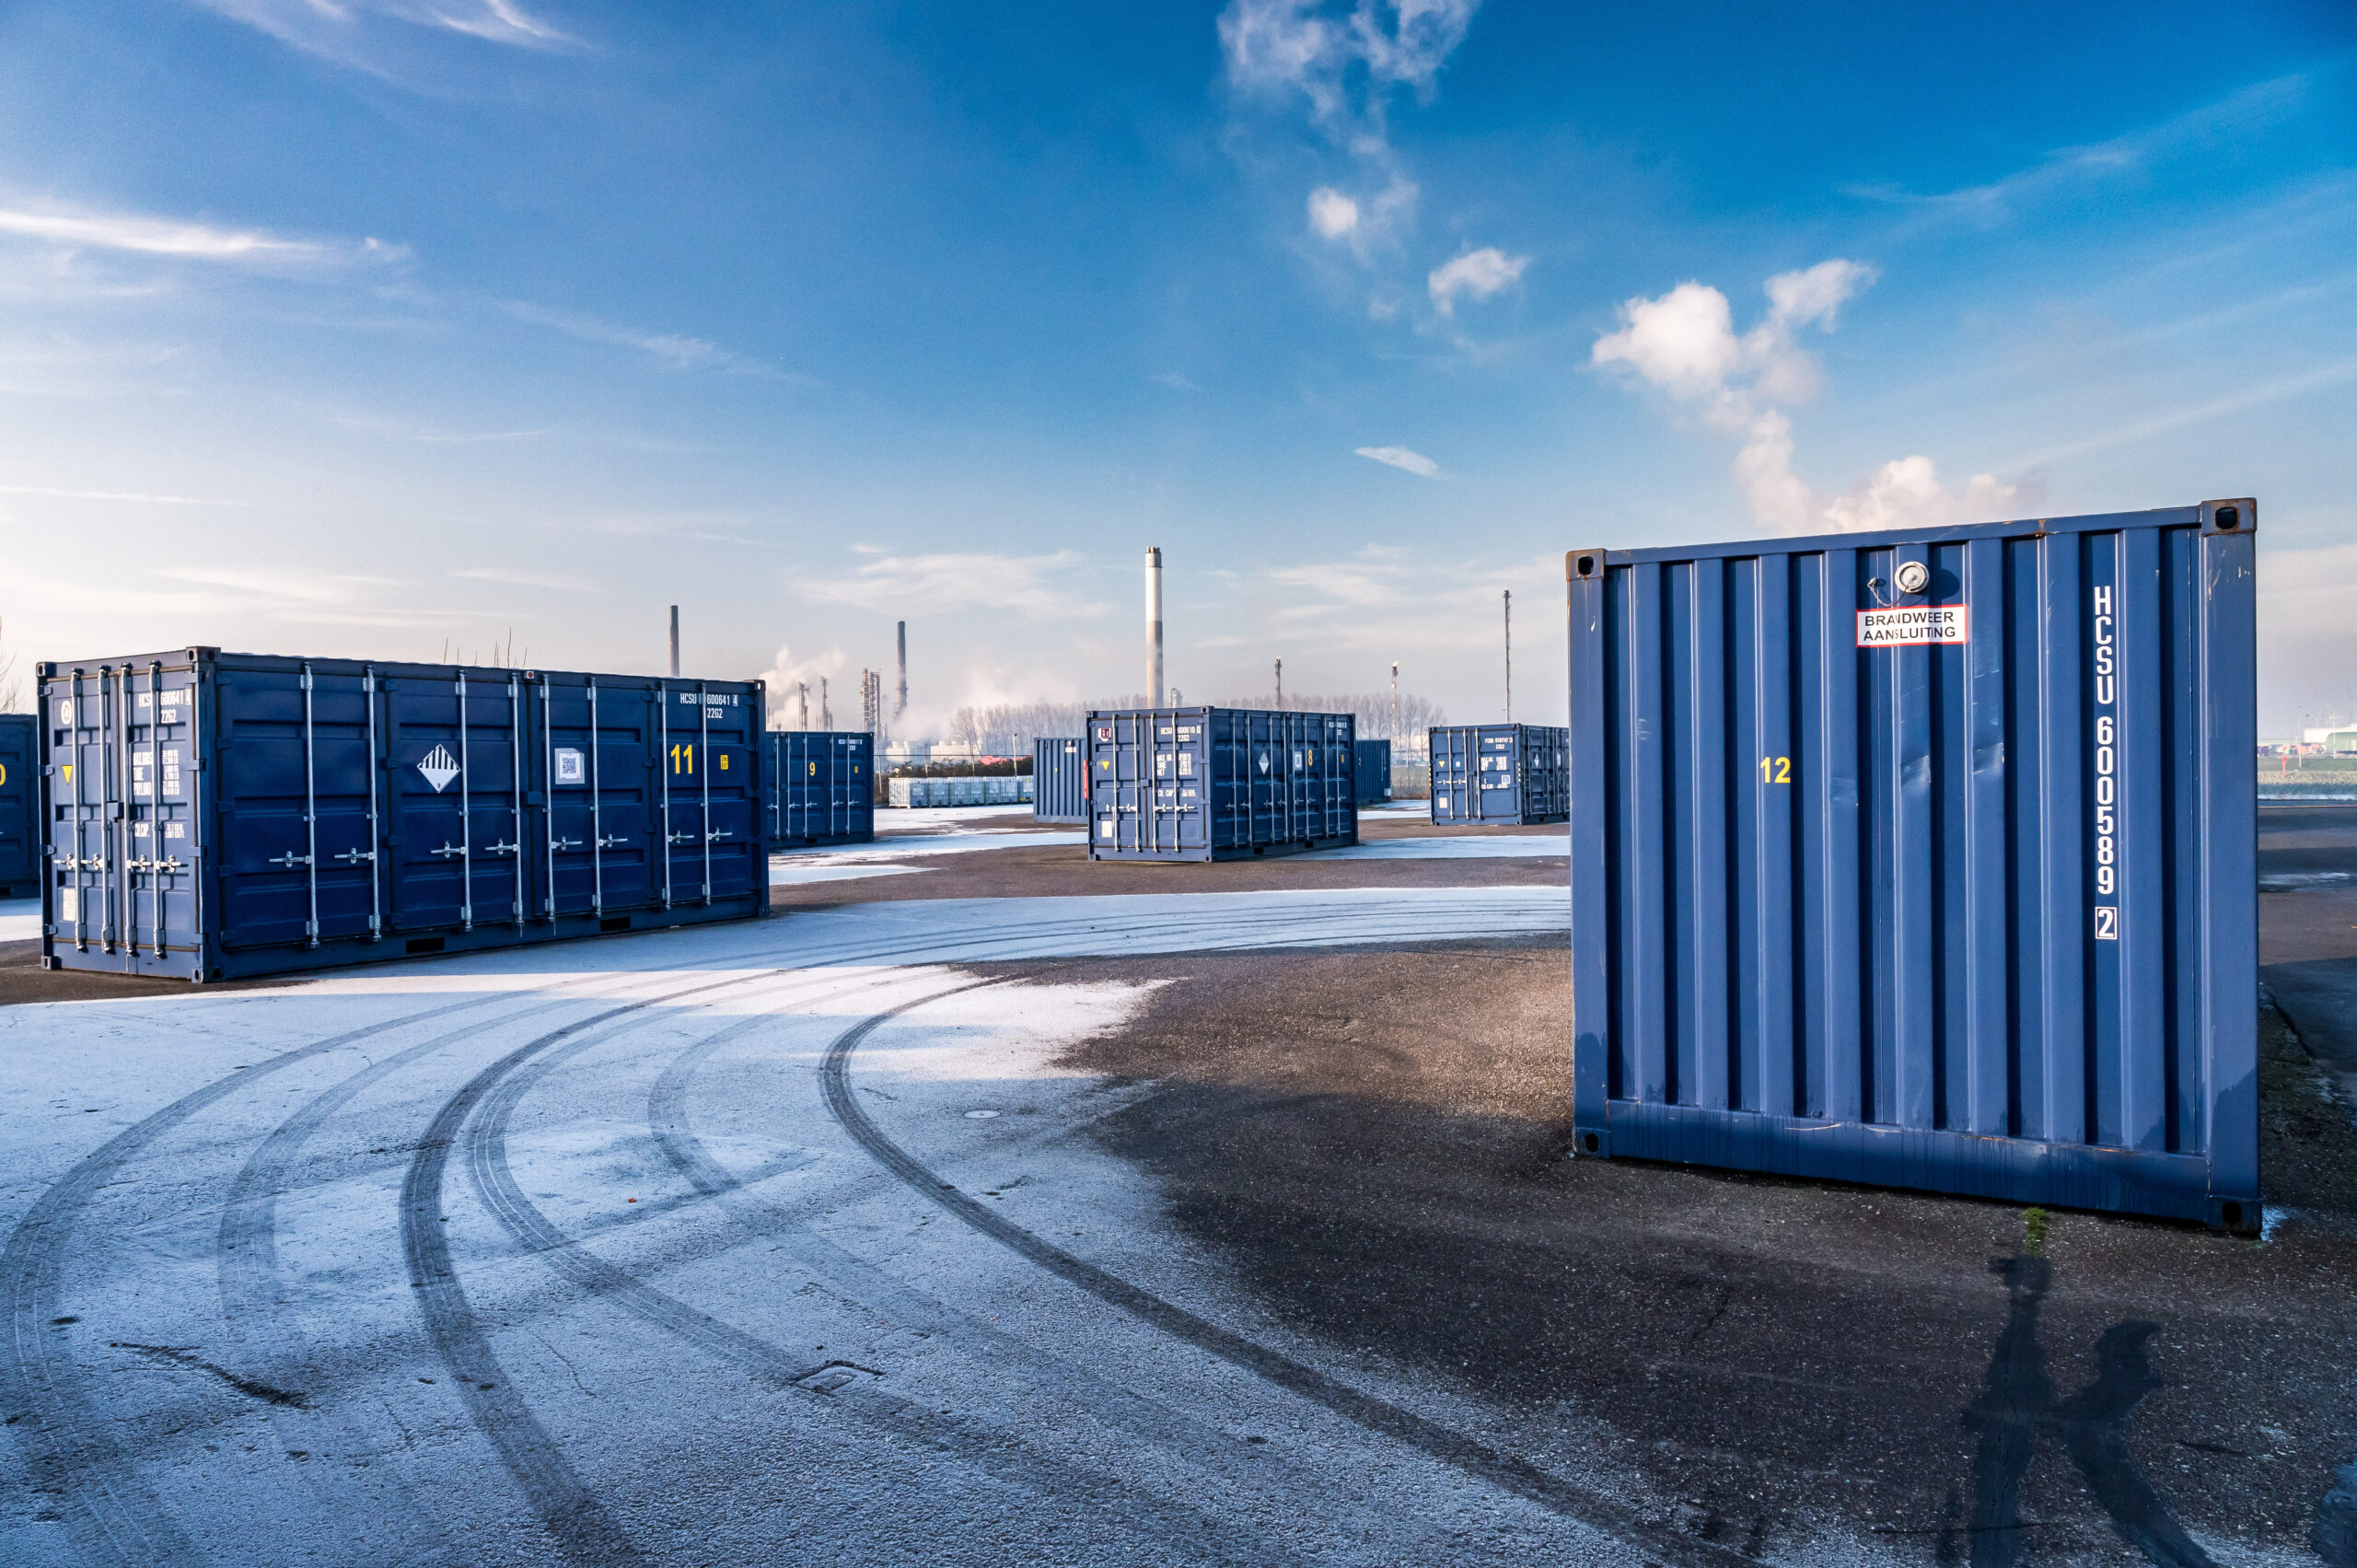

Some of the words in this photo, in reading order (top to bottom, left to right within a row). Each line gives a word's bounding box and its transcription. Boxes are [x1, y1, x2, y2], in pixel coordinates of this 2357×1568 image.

[1864, 611, 1954, 626] BRANDWEER
[1864, 627, 1956, 641] AANSLUITING
[2095, 586, 2114, 704] HCSU
[139, 692, 153, 707] HCS
[680, 692, 697, 703] HCSU
[706, 693, 730, 705] 600641
[733, 694, 738, 706] 4
[707, 708, 723, 718] 22G2
[670, 744, 693, 774] 11
[1308, 749, 1314, 766] 8
[809, 761, 816, 776] 9
[1759, 756, 1791, 784] 12
[2096, 715, 2115, 895] 600589
[2096, 908, 2116, 938] 2
